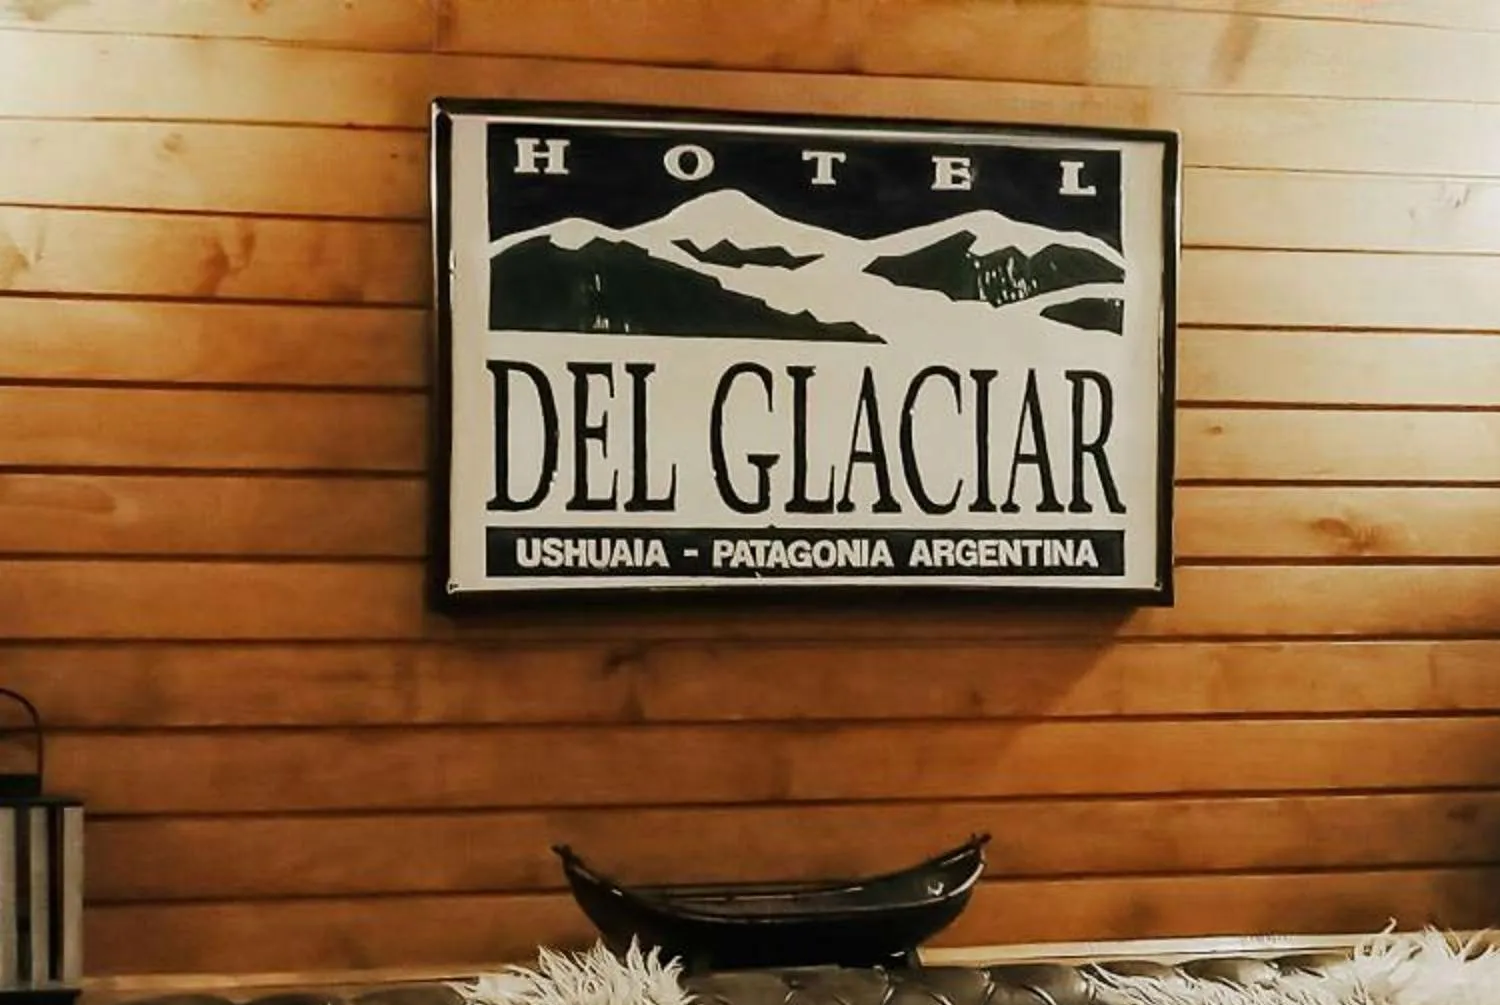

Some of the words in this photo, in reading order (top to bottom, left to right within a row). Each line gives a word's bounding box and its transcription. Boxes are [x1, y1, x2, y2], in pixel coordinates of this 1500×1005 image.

[514, 138, 1096, 196] HOTEL
[485, 359, 678, 513] DEL
[708, 361, 1128, 515] GLACIAR
[515, 538, 670, 568] USHUAIA
[711, 538, 896, 569] PATAGONIA
[908, 539, 1099, 569] ARGENTINA
